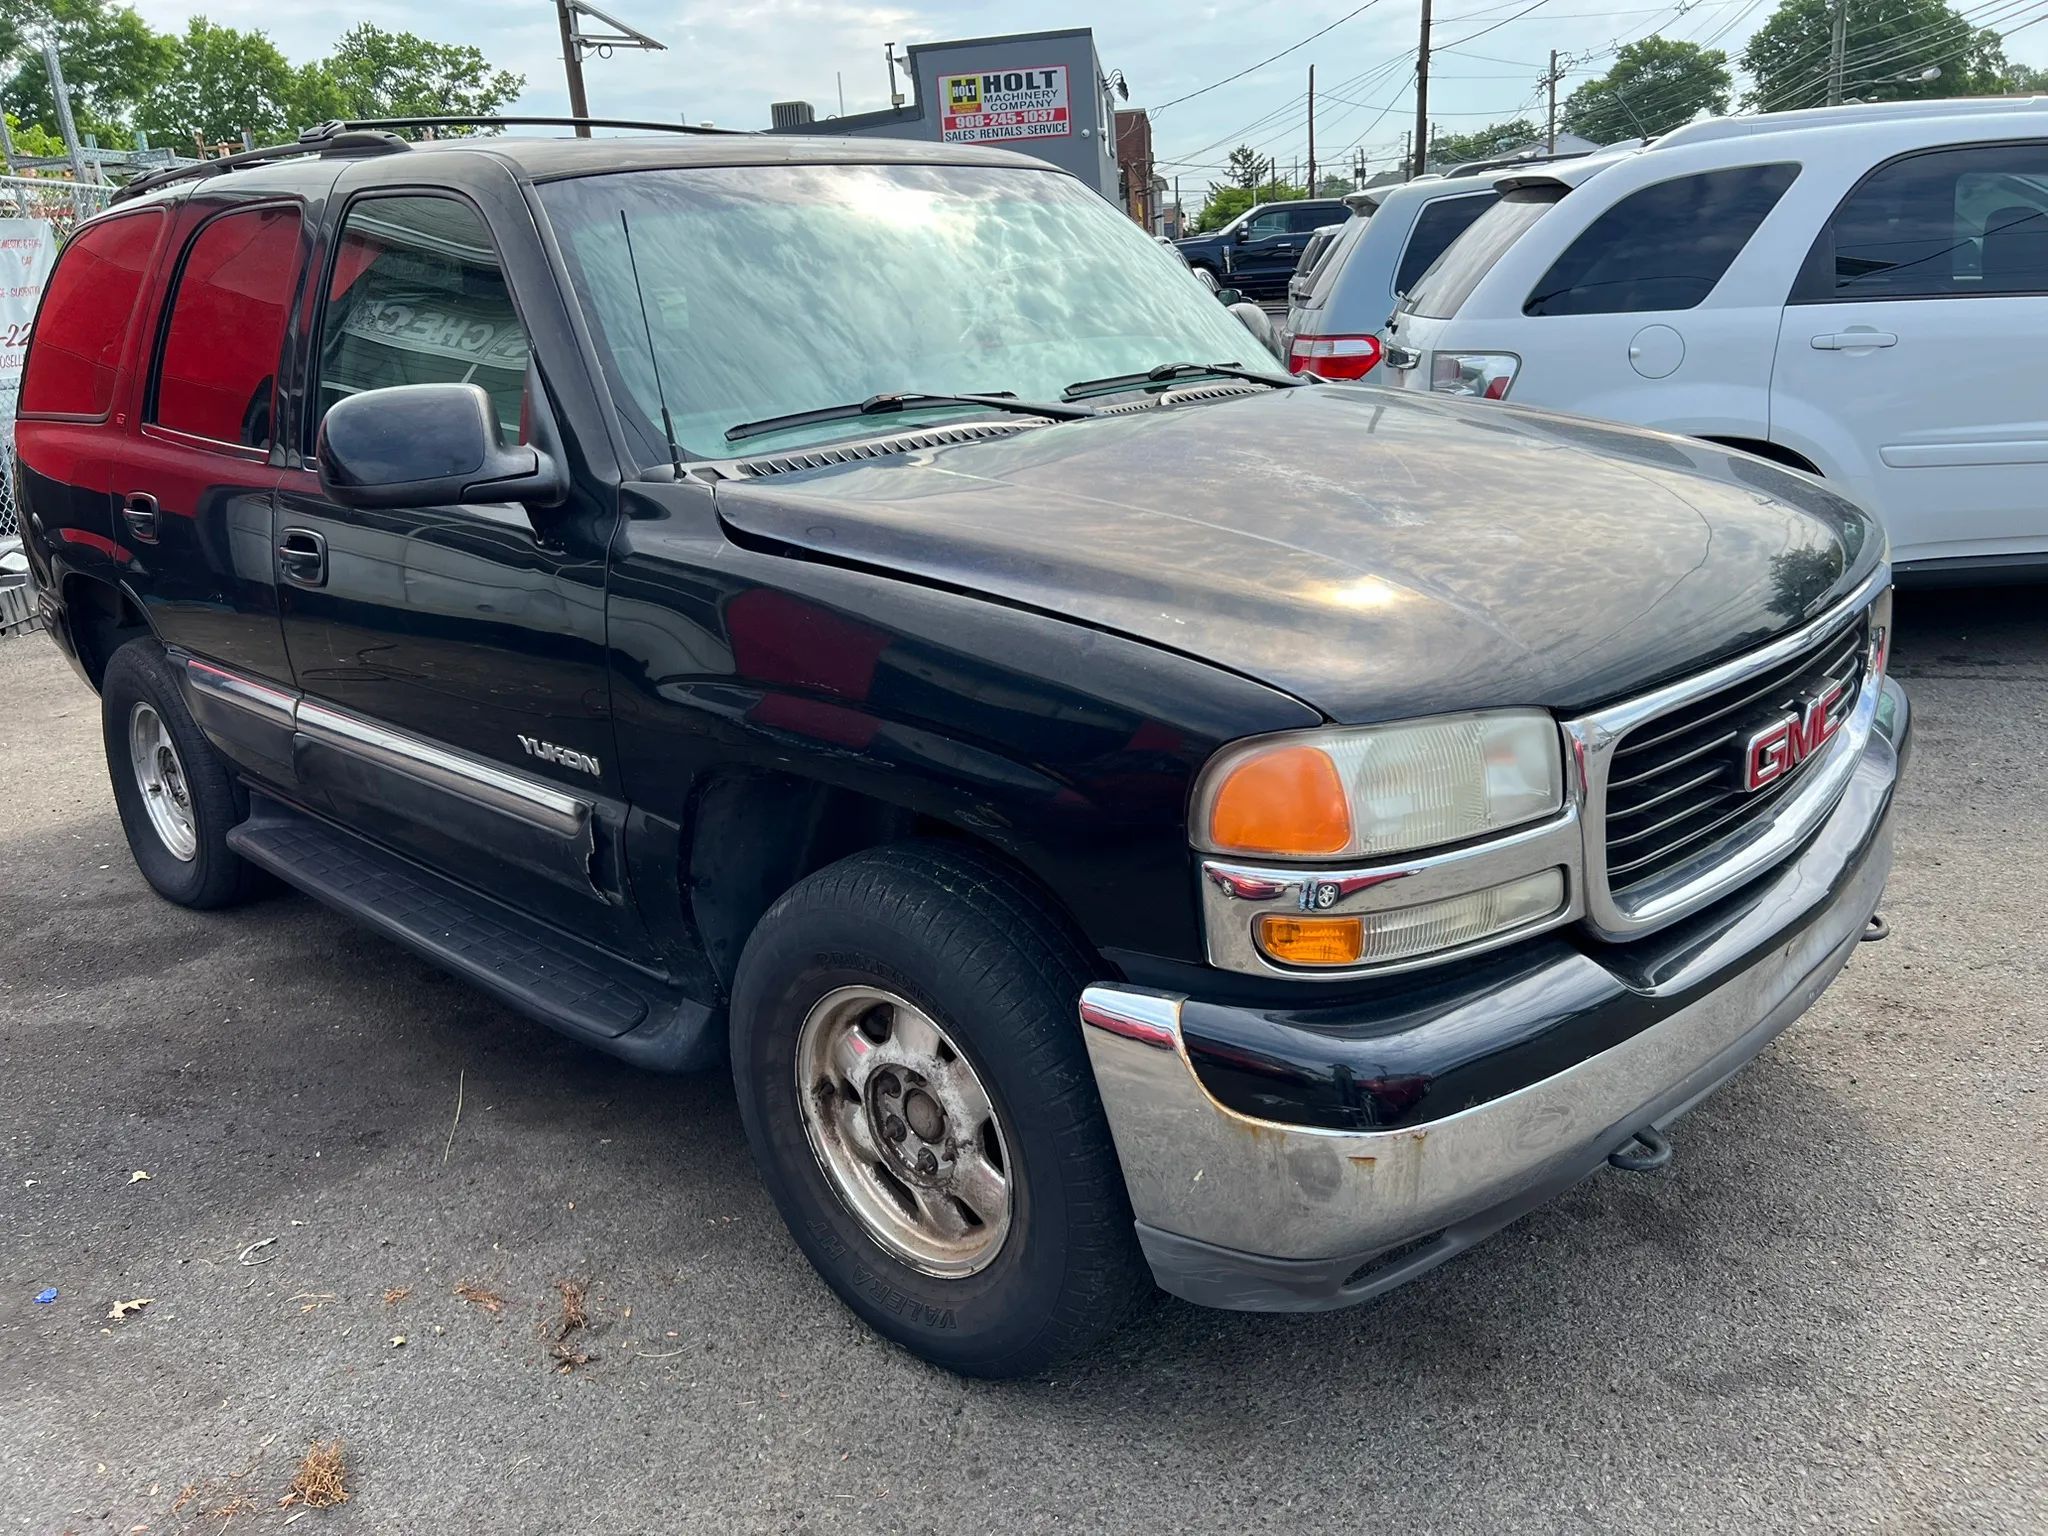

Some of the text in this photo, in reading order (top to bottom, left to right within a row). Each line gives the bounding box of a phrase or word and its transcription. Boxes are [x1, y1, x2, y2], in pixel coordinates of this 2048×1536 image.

[952, 84, 976, 98] HOLT
[982, 70, 1058, 94] HOLT
[983, 89, 1059, 103] MACHINERY
[990, 99, 1053, 112] COMPANY
[955, 109, 1056, 129] 908-245-1037
[945, 122, 1067, 142] SALES RENTALS SERVICE
[1745, 680, 1843, 792] GMC
[517, 734, 600, 776] YUKON
[806, 1219, 959, 1329] VALERA HT
